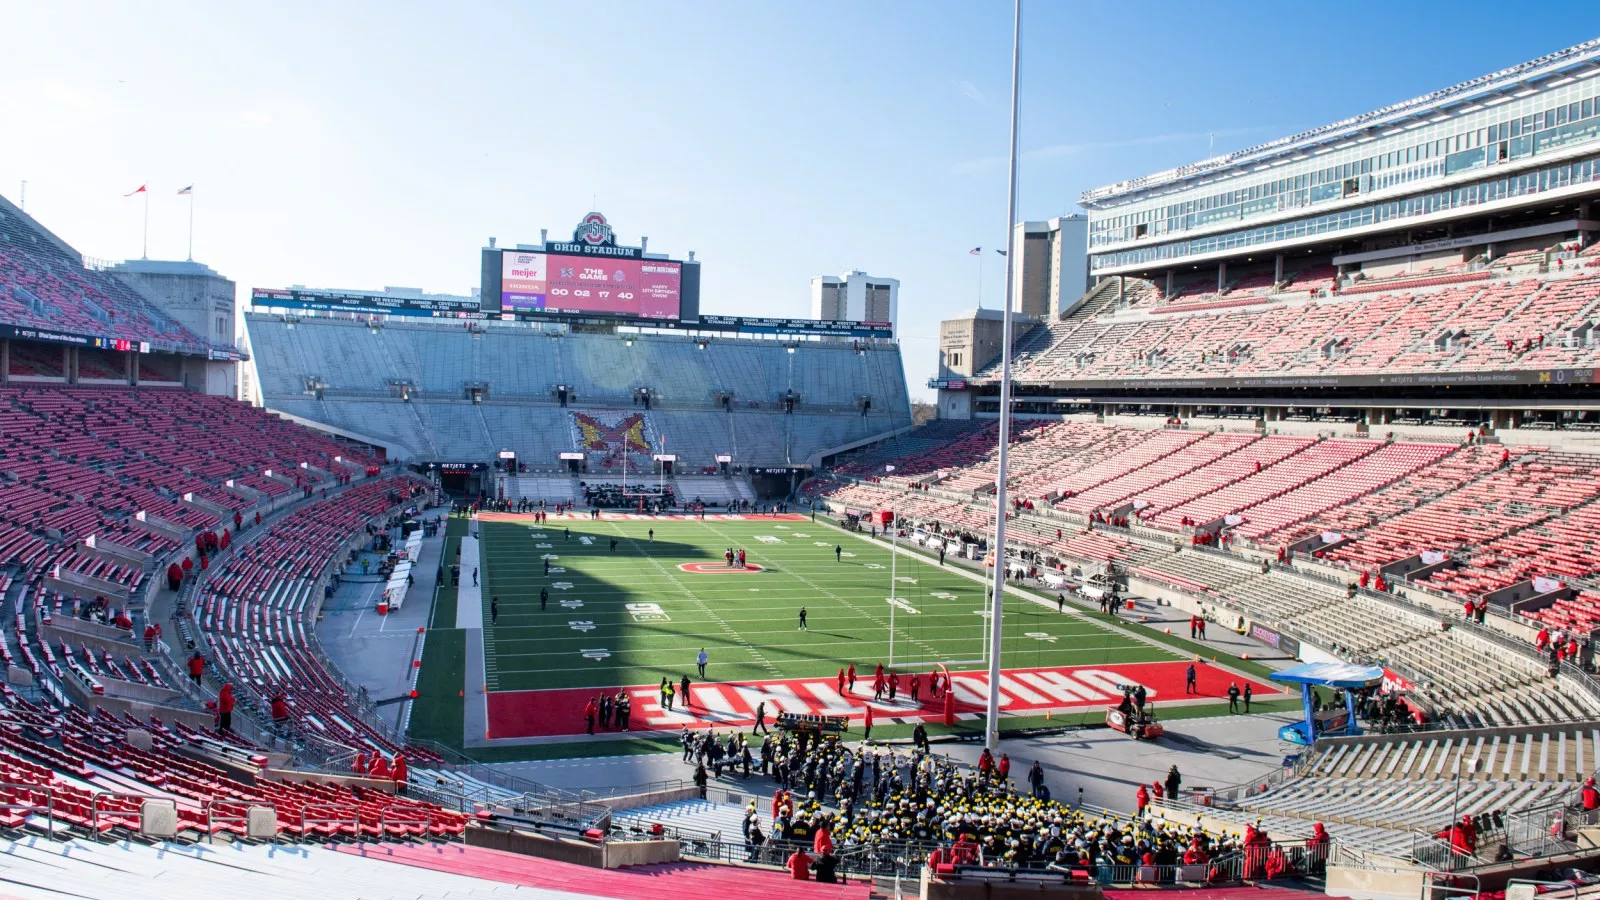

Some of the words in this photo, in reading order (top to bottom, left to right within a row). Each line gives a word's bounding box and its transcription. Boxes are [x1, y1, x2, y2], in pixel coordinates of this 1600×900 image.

[578, 224, 592, 241] OHIO
[592, 222, 611, 244] STATE
[554, 244, 581, 252] OHIO
[584, 246, 634, 256] STADIUM
[512, 268, 537, 278] meijer
[1539, 371, 1551, 382] M
[1557, 370, 1564, 381] 0
[936, 669, 1158, 706] OHIO
[632, 680, 924, 726] STATE
